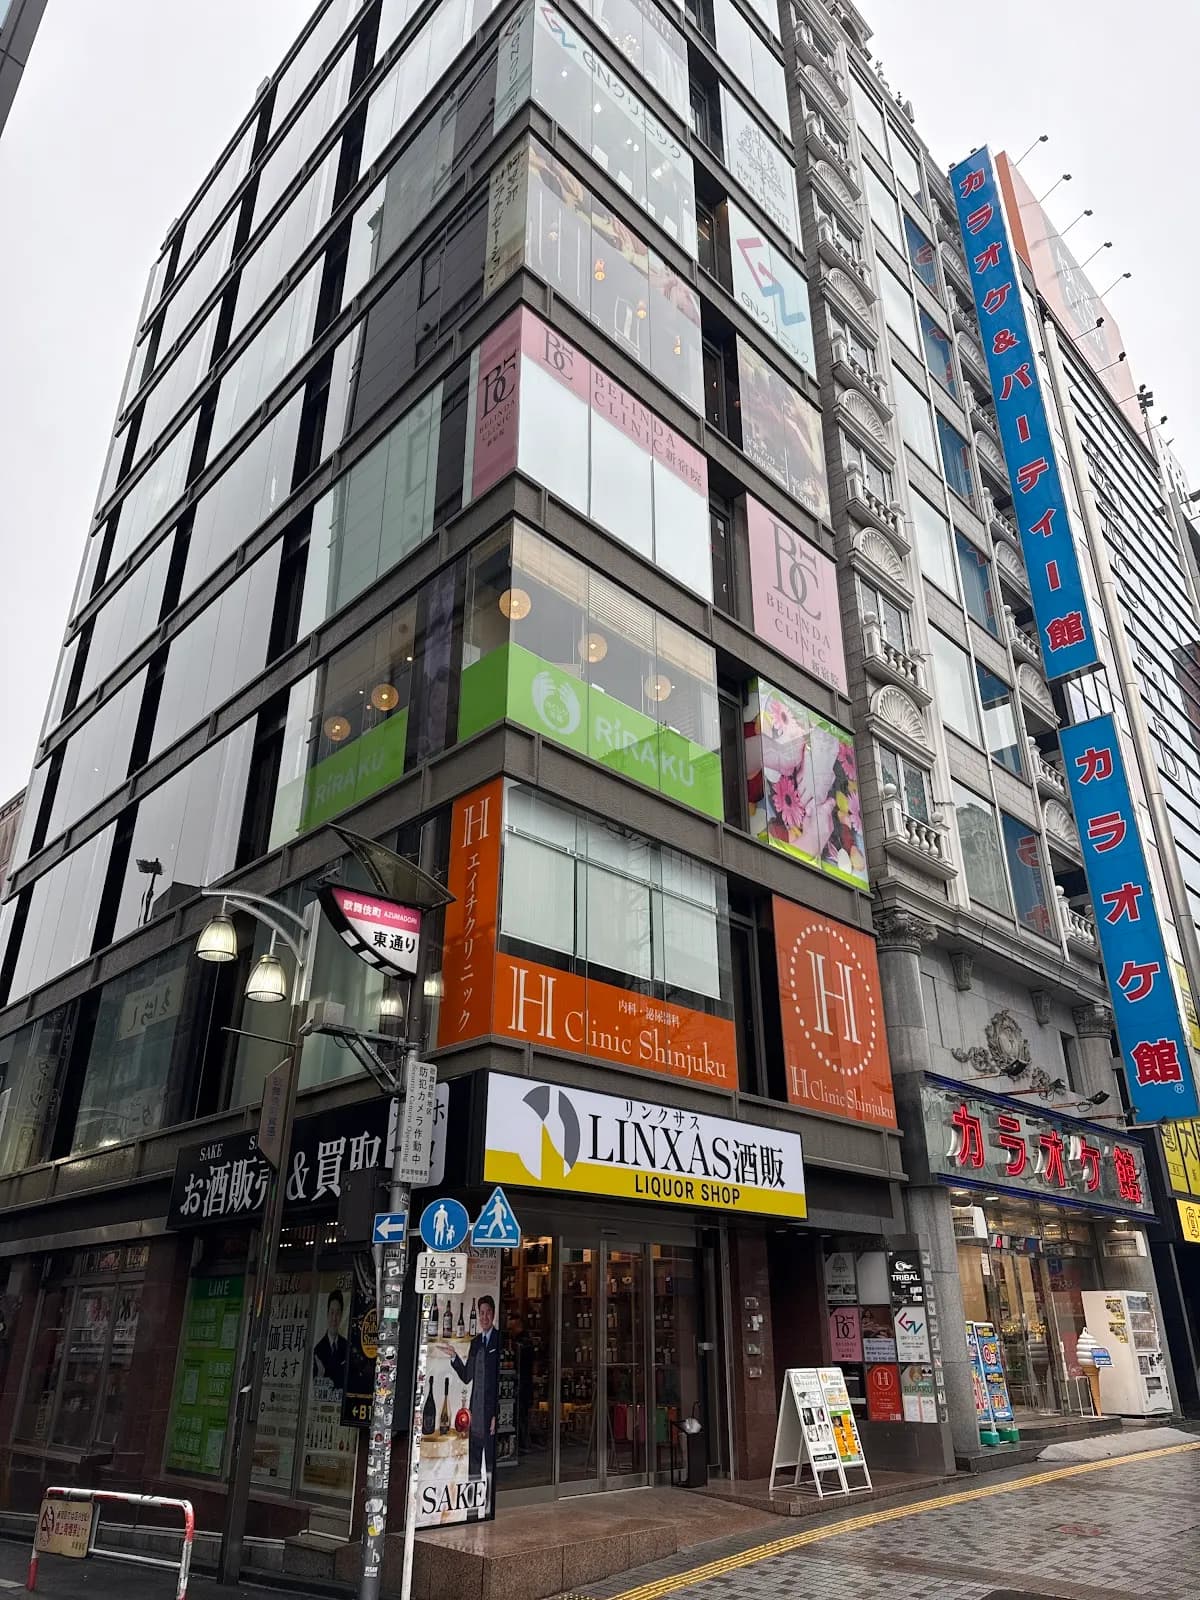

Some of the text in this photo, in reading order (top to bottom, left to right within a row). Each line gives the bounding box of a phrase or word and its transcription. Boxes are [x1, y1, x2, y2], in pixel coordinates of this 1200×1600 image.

[479, 399, 516, 436] BELINDA
[594, 391, 665, 455] CLINIC
[595, 370, 676, 448] BELINDA
[766, 591, 831, 649] BELINDA
[774, 617, 826, 663] CLINIC
[343, 899, 382, 918] 歌舞伎町
[1075, 747, 1184, 1087] カラオケ館
[372, 931, 416, 954] 東通り
[458, 853, 481, 1033] エイチクリニック
[507, 966, 728, 1079] H Clinic Shinjuku
[806, 950, 862, 1045] H
[411, 1066, 430, 1165] 防犯カメラ作動中
[625, 1100, 700, 1130] リンクサス
[810, 1080, 845, 1108] Clinic
[847, 1089, 894, 1121] Shinjuku
[200, 1143, 224, 1162] SAKE
[588, 1113, 786, 1188] LINXAS酒販
[952, 1103, 1142, 1203] カラオケ館
[634, 1174, 741, 1206] LIQUOR SHOP
[208, 1280, 230, 1297] LINE
[422, 1481, 487, 1514] SAKE
